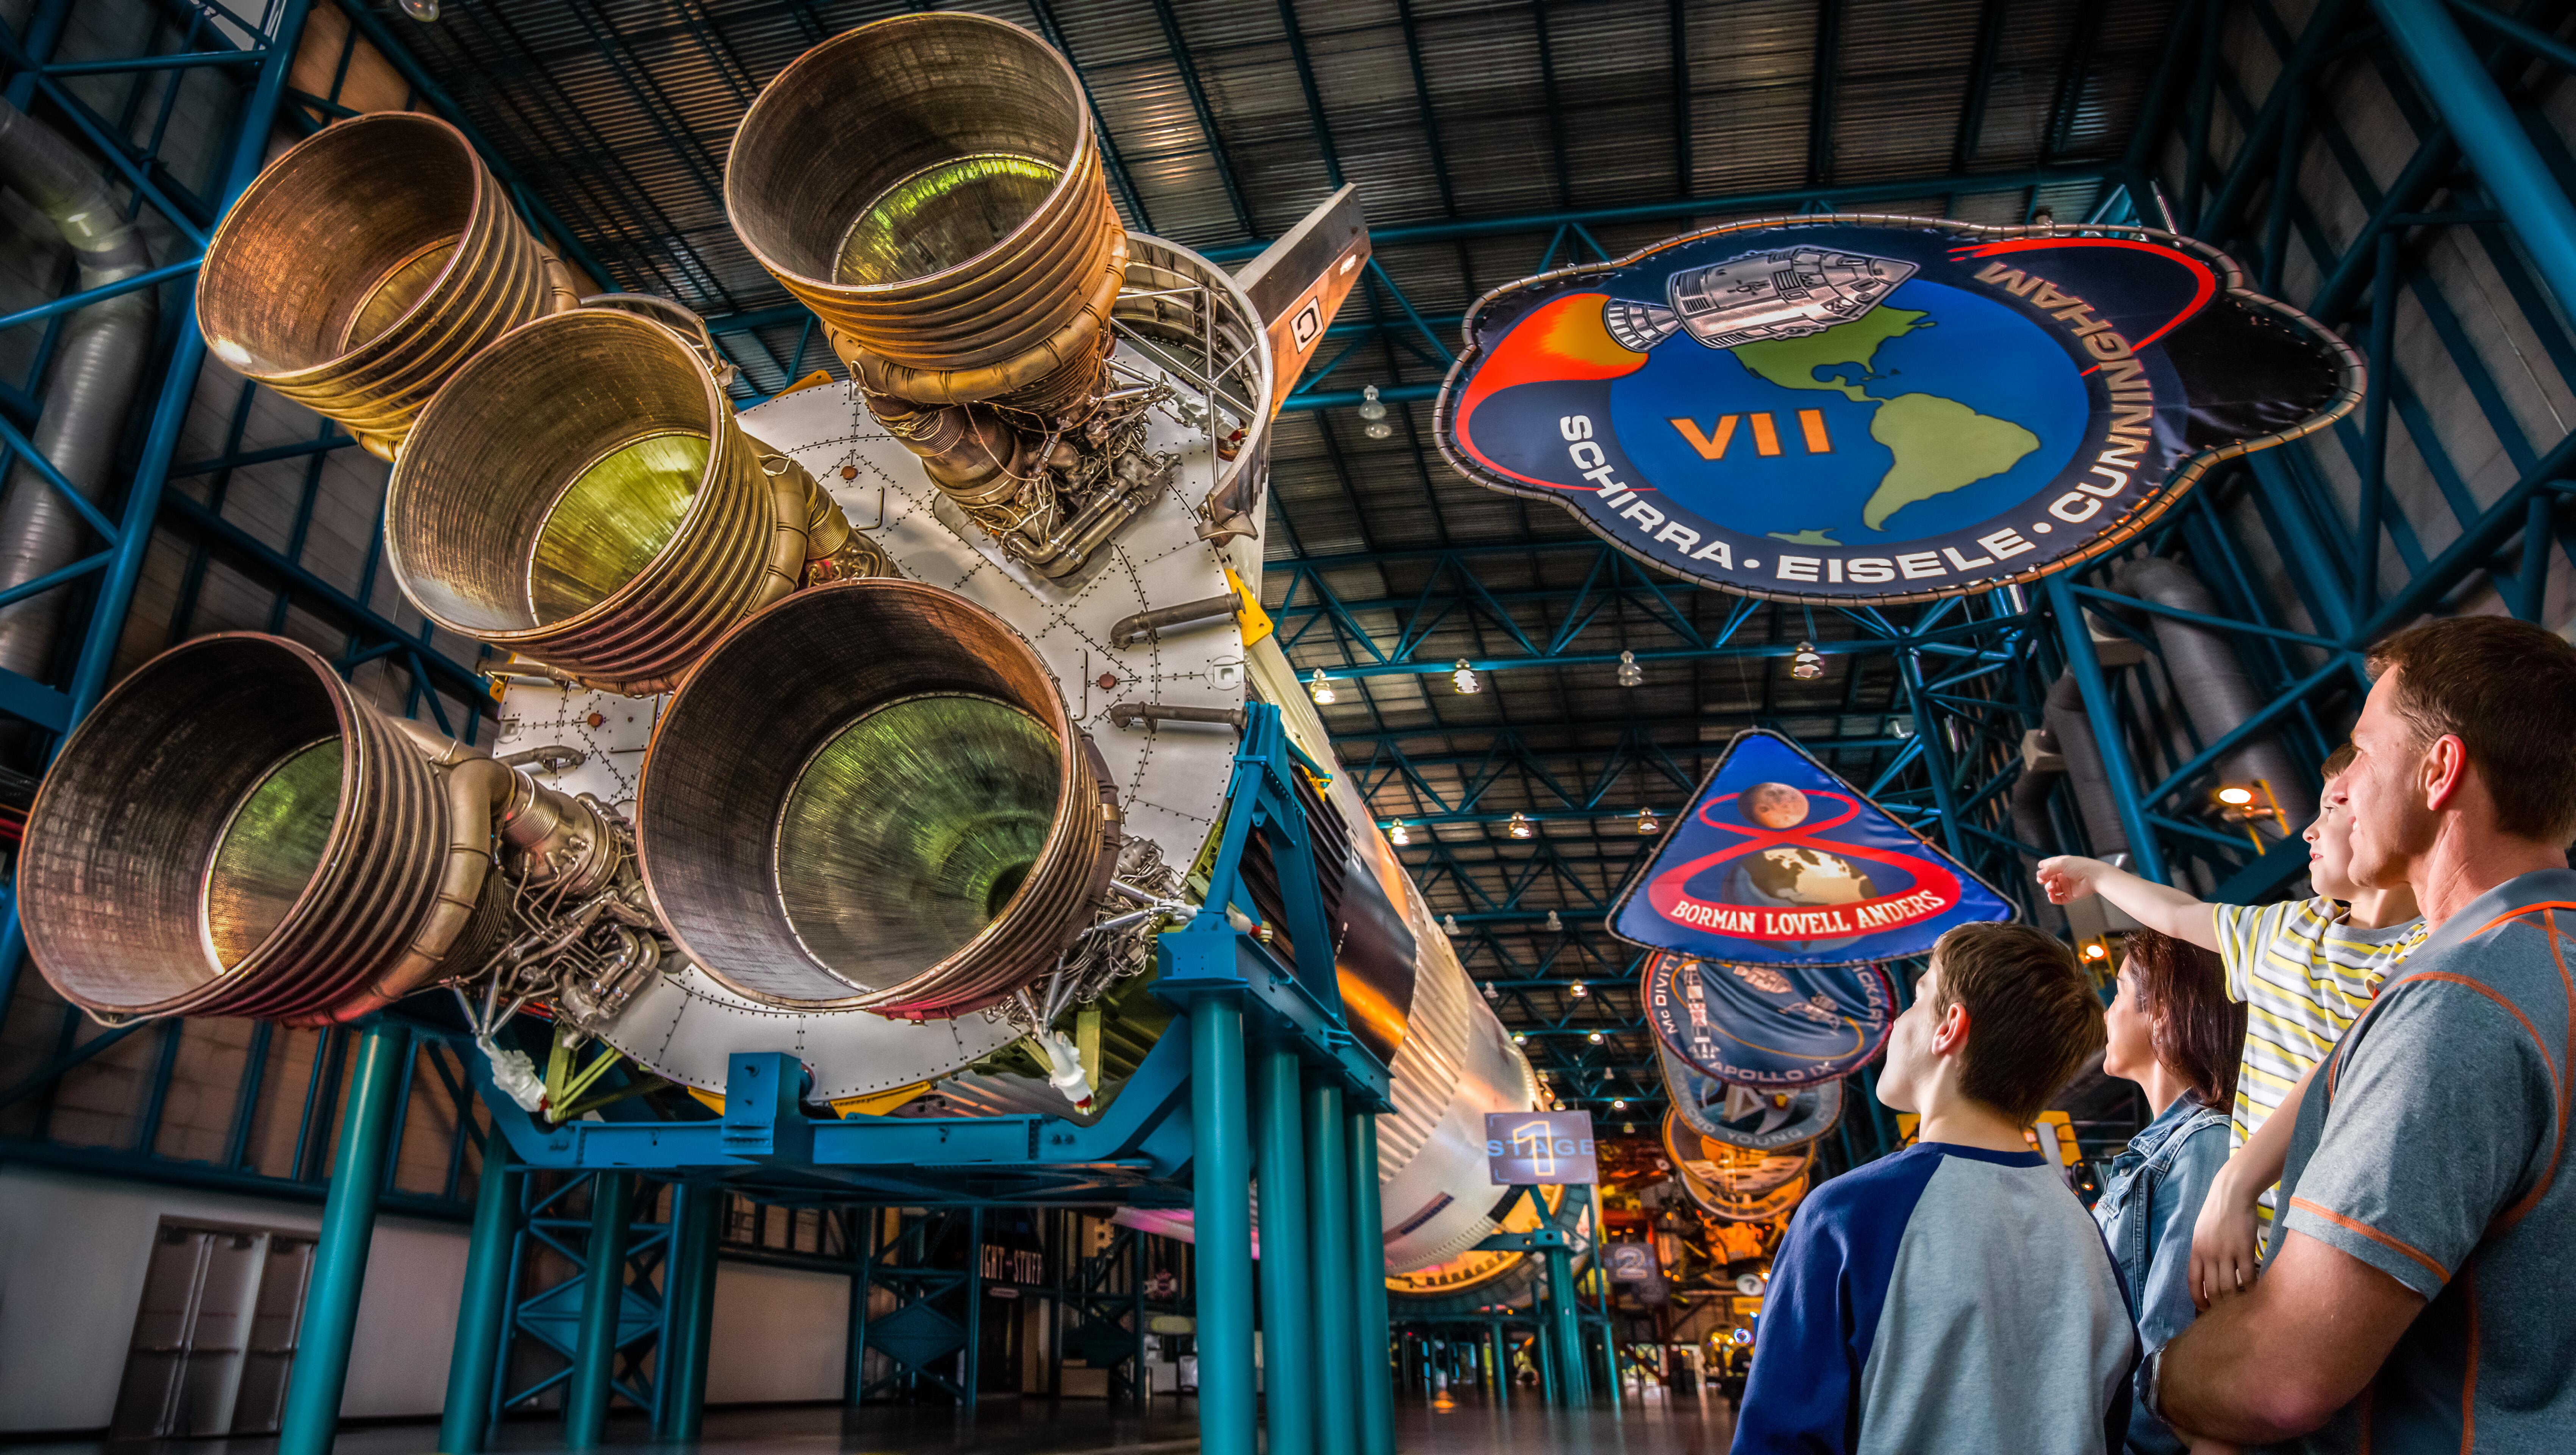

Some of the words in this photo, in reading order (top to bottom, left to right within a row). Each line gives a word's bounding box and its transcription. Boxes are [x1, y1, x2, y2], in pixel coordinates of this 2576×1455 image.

[1560, 415, 1733, 570] SCHIRRA
[1776, 527, 2036, 583] EISELE
[1974, 261, 2154, 523] CUNNINGHAM
[1668, 408, 1834, 461] VII
[1670, 900, 1756, 933] BORMAN
[1765, 911, 1852, 936] LOVELL
[1855, 889, 1946, 929] ANDERS
[1852, 967, 1884, 1031] ICKART
[1707, 1061, 1805, 1082] APOLLO
[1809, 1061, 1836, 1077] IX
[1487, 1138, 1594, 1157] STAGE
[1512, 1120, 1555, 1177] 1
[1726, 1128, 1803, 1146] YOUNG
[980, 1242, 1006, 1280] IGHT
[1615, 1246, 1648, 1280] 2
